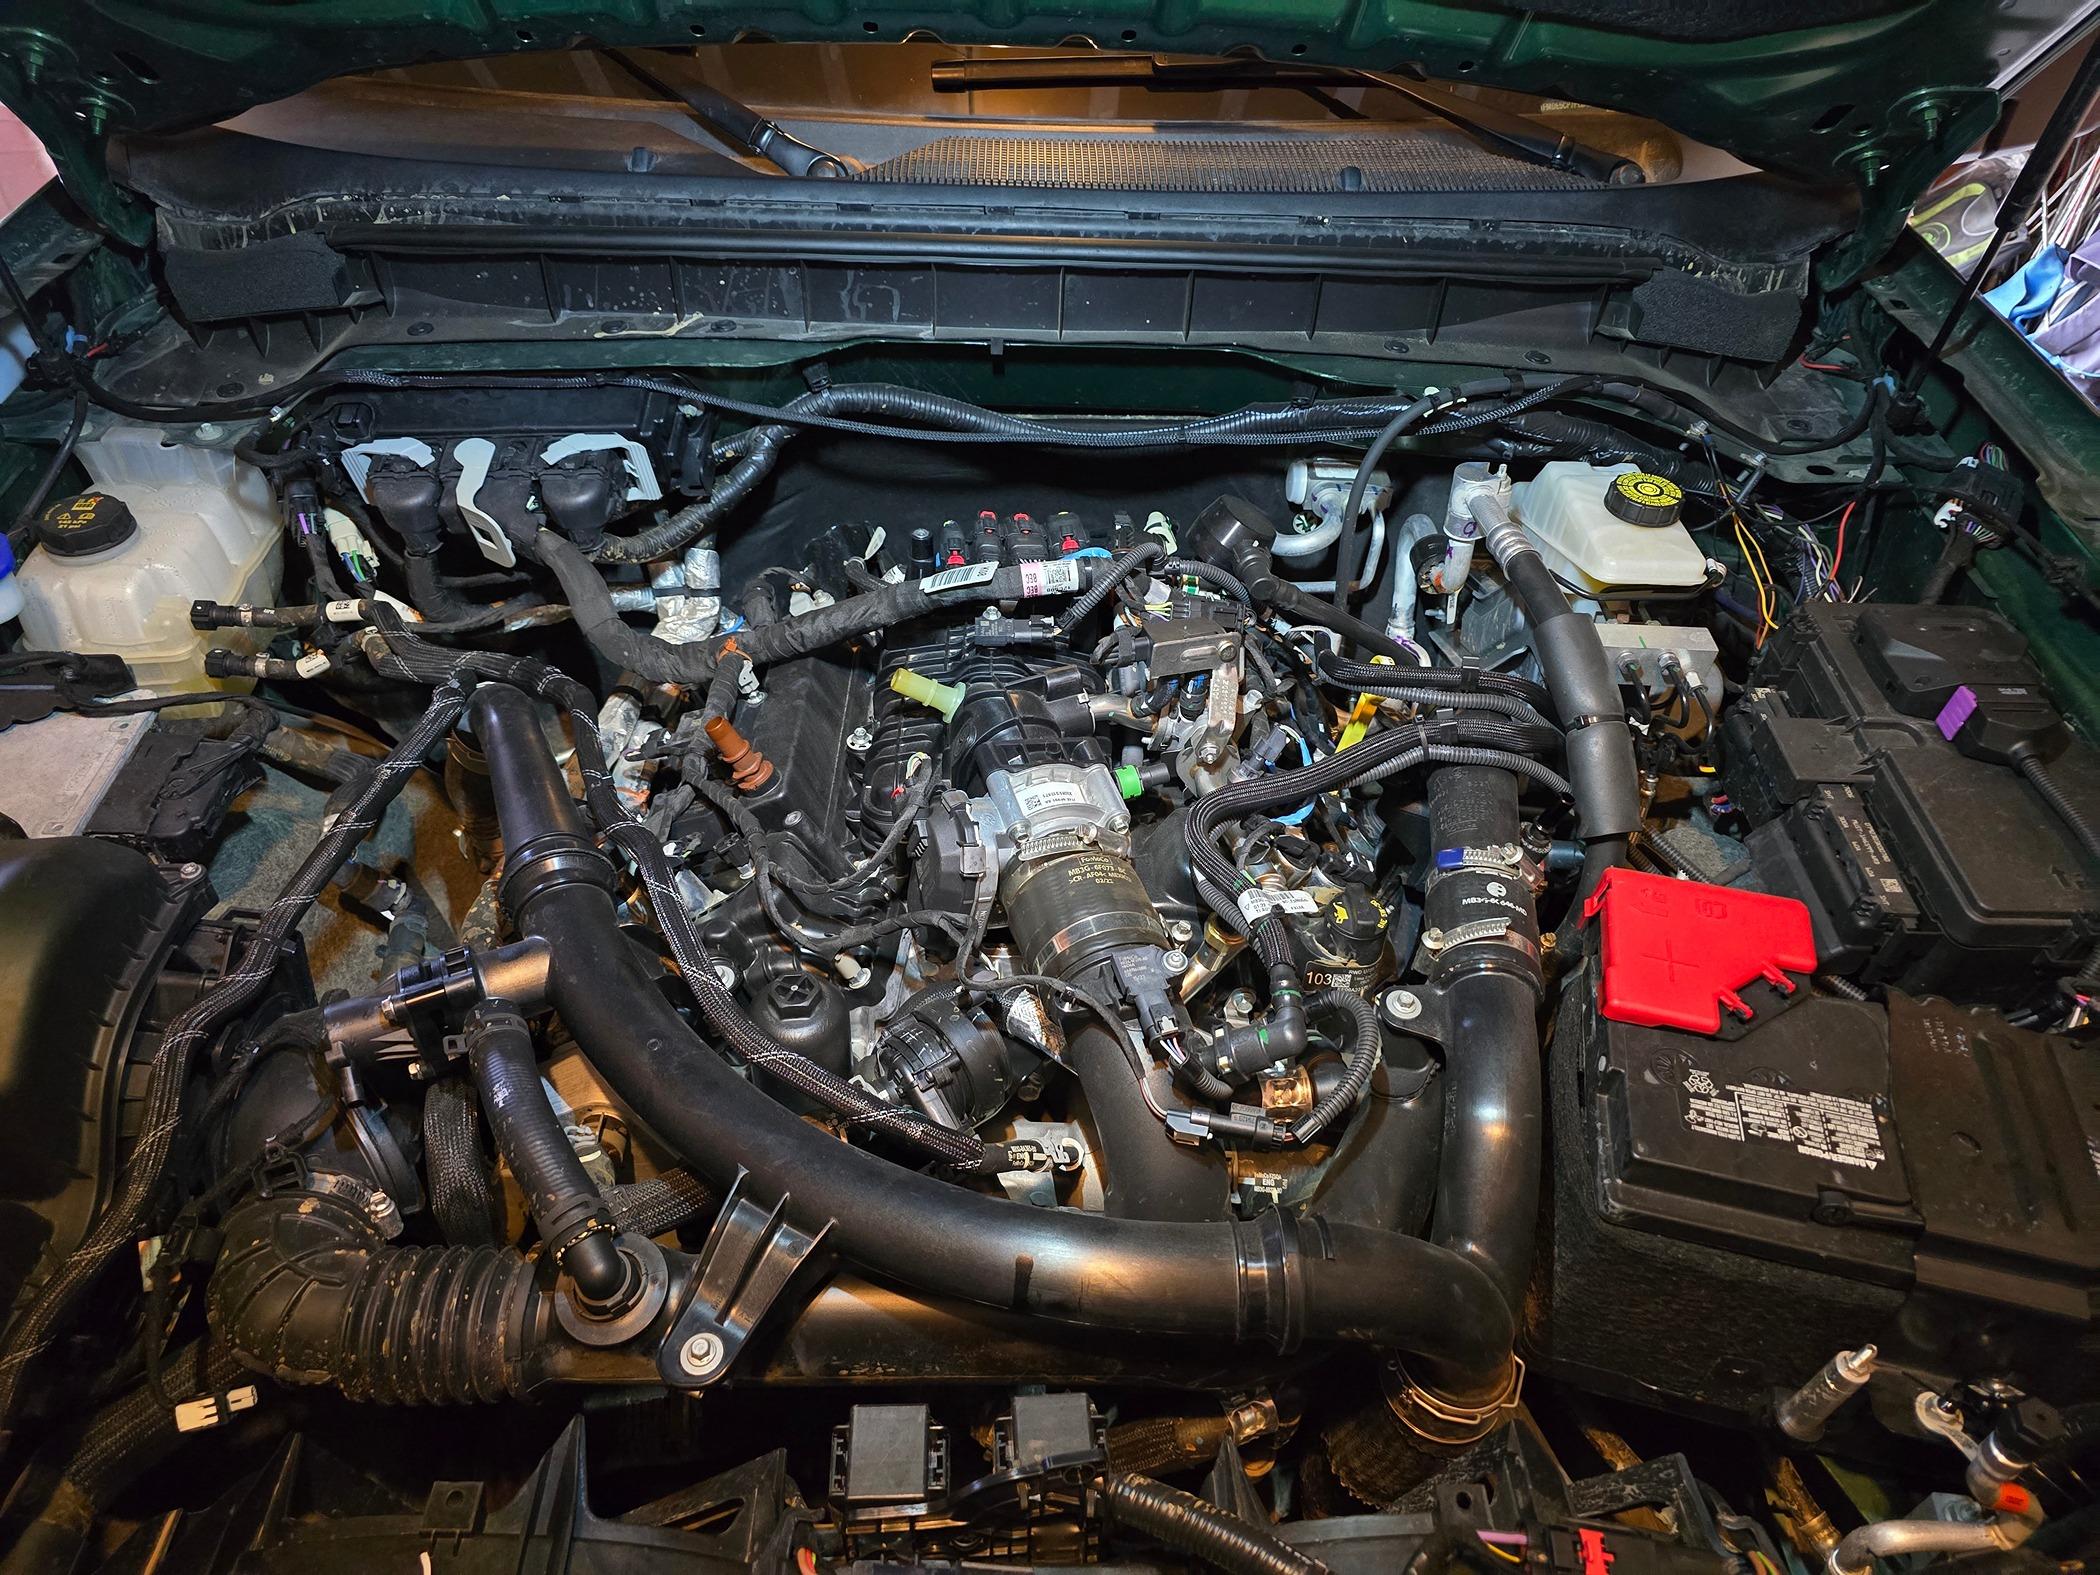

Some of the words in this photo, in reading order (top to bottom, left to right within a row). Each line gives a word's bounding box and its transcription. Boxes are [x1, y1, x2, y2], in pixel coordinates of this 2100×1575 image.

[1025, 573, 1037, 584] BEC
[1026, 584, 1038, 594] BEC
[1306, 971, 1332, 985] 103
